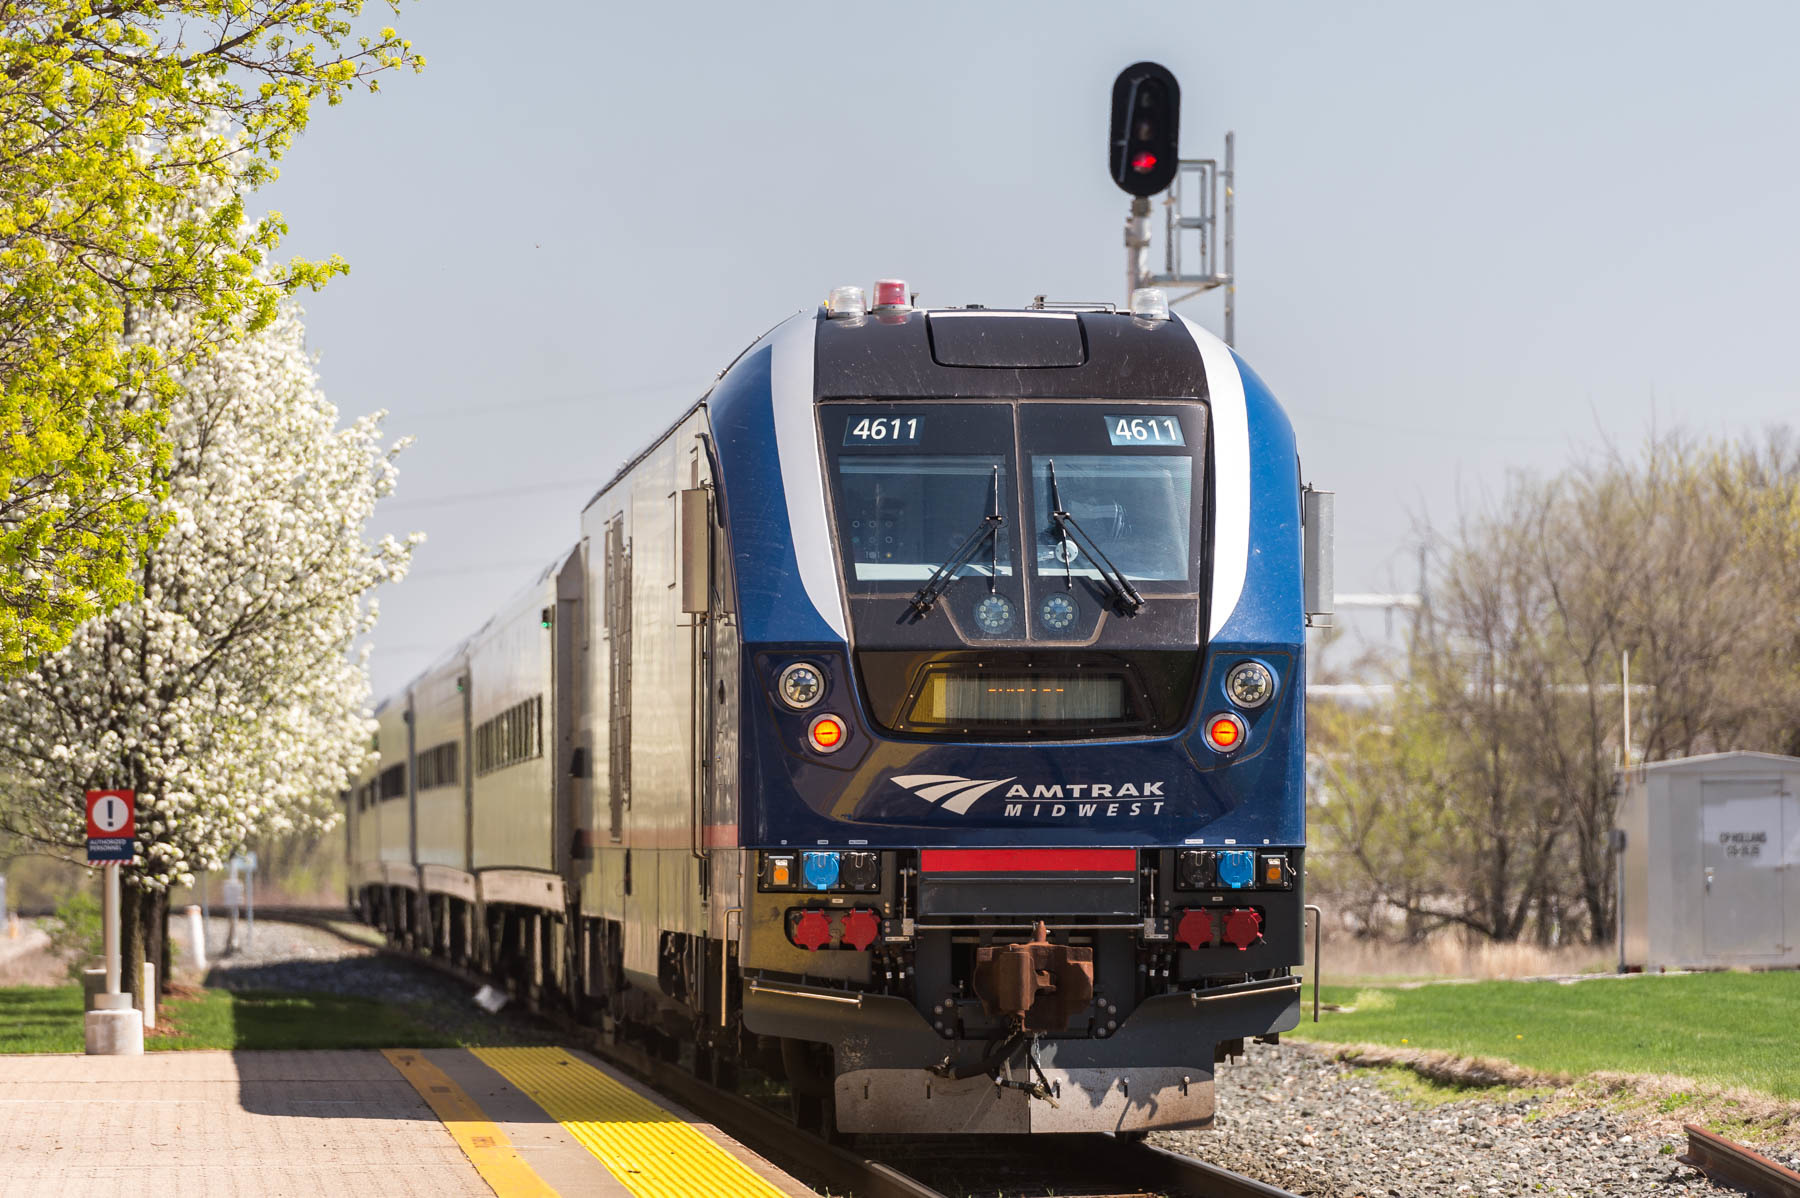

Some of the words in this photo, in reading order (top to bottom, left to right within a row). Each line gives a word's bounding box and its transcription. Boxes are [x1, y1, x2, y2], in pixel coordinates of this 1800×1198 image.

[852, 417, 918, 440] 4611
[1114, 418, 1177, 441] 4611
[1005, 781, 1164, 798] AMTRAK
[1004, 801, 1165, 817] MIDWEST
